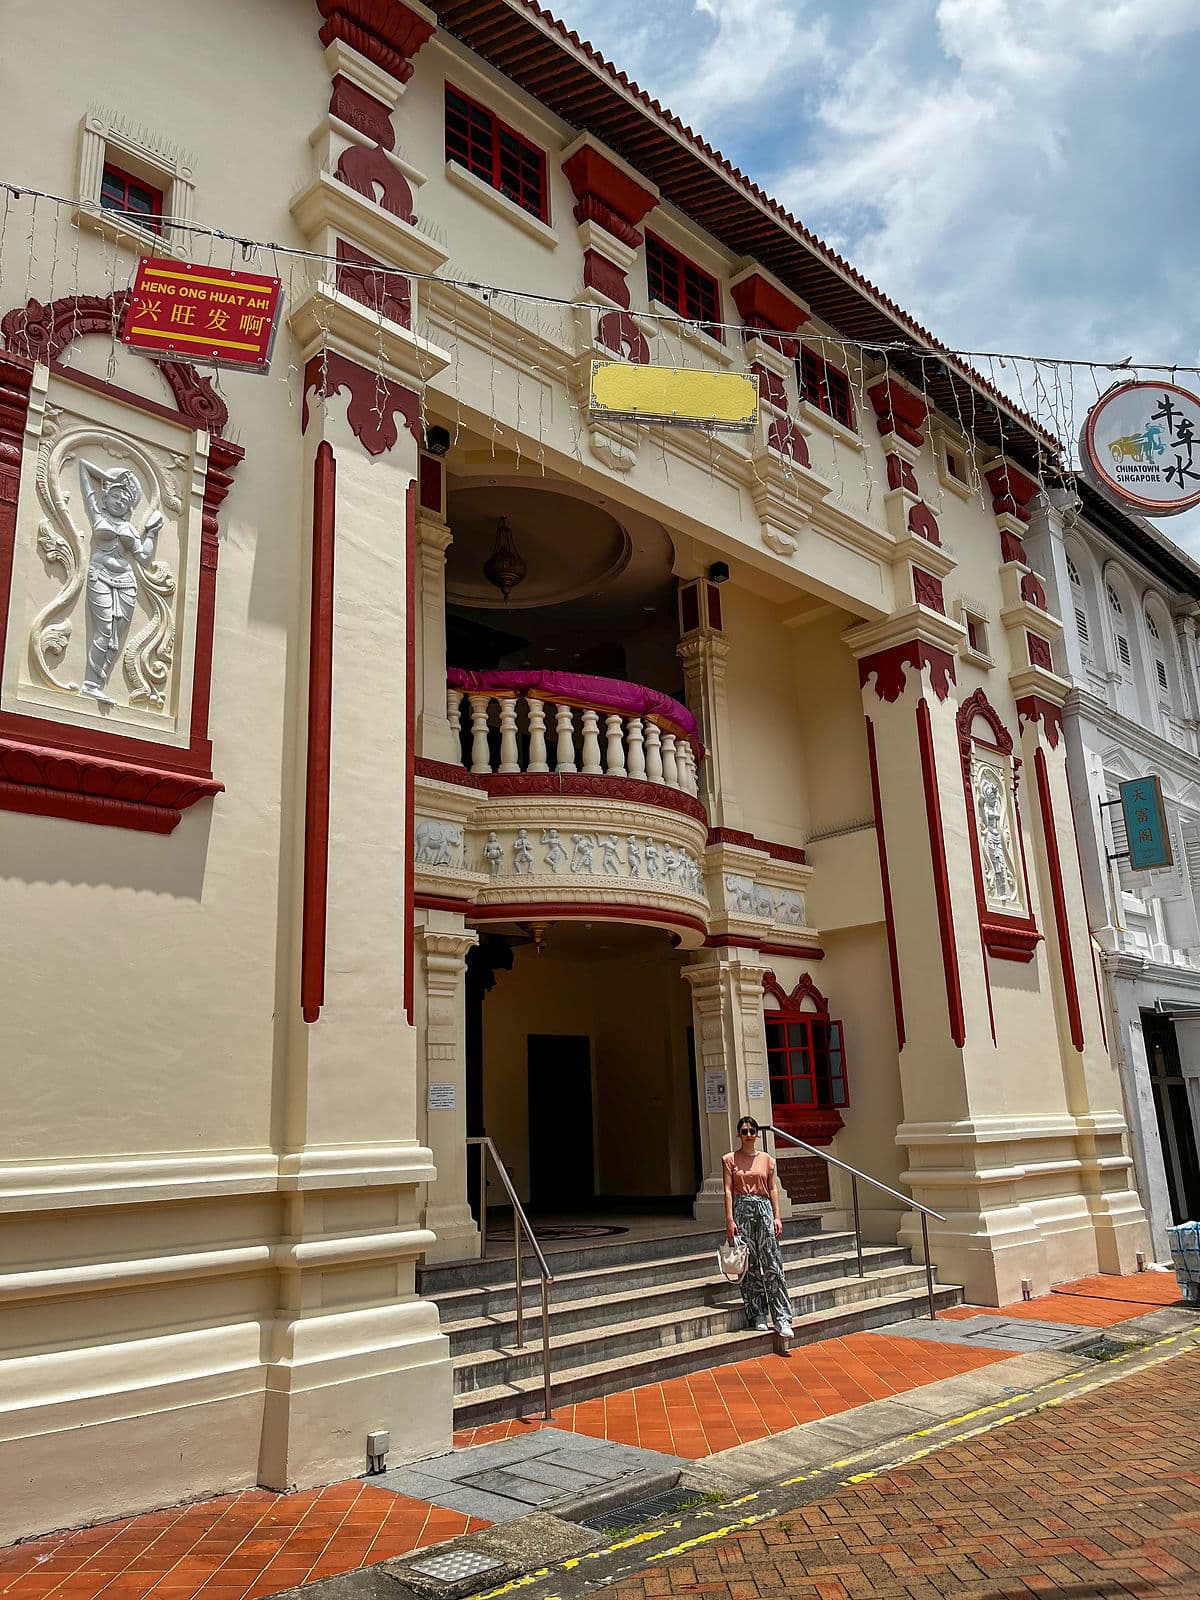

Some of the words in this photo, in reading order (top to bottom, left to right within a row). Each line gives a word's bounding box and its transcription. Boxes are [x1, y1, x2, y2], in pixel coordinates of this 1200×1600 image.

[141, 281, 176, 295] HENG
[179, 287, 207, 300] ONG
[210, 292, 245, 306] HUAT
[247, 300, 270, 310] AH!
[134, 299, 266, 337] 兴旺发啊
[1115, 465, 1160, 473] CHINATOWN
[1116, 474, 1161, 482] SINGAPORE
